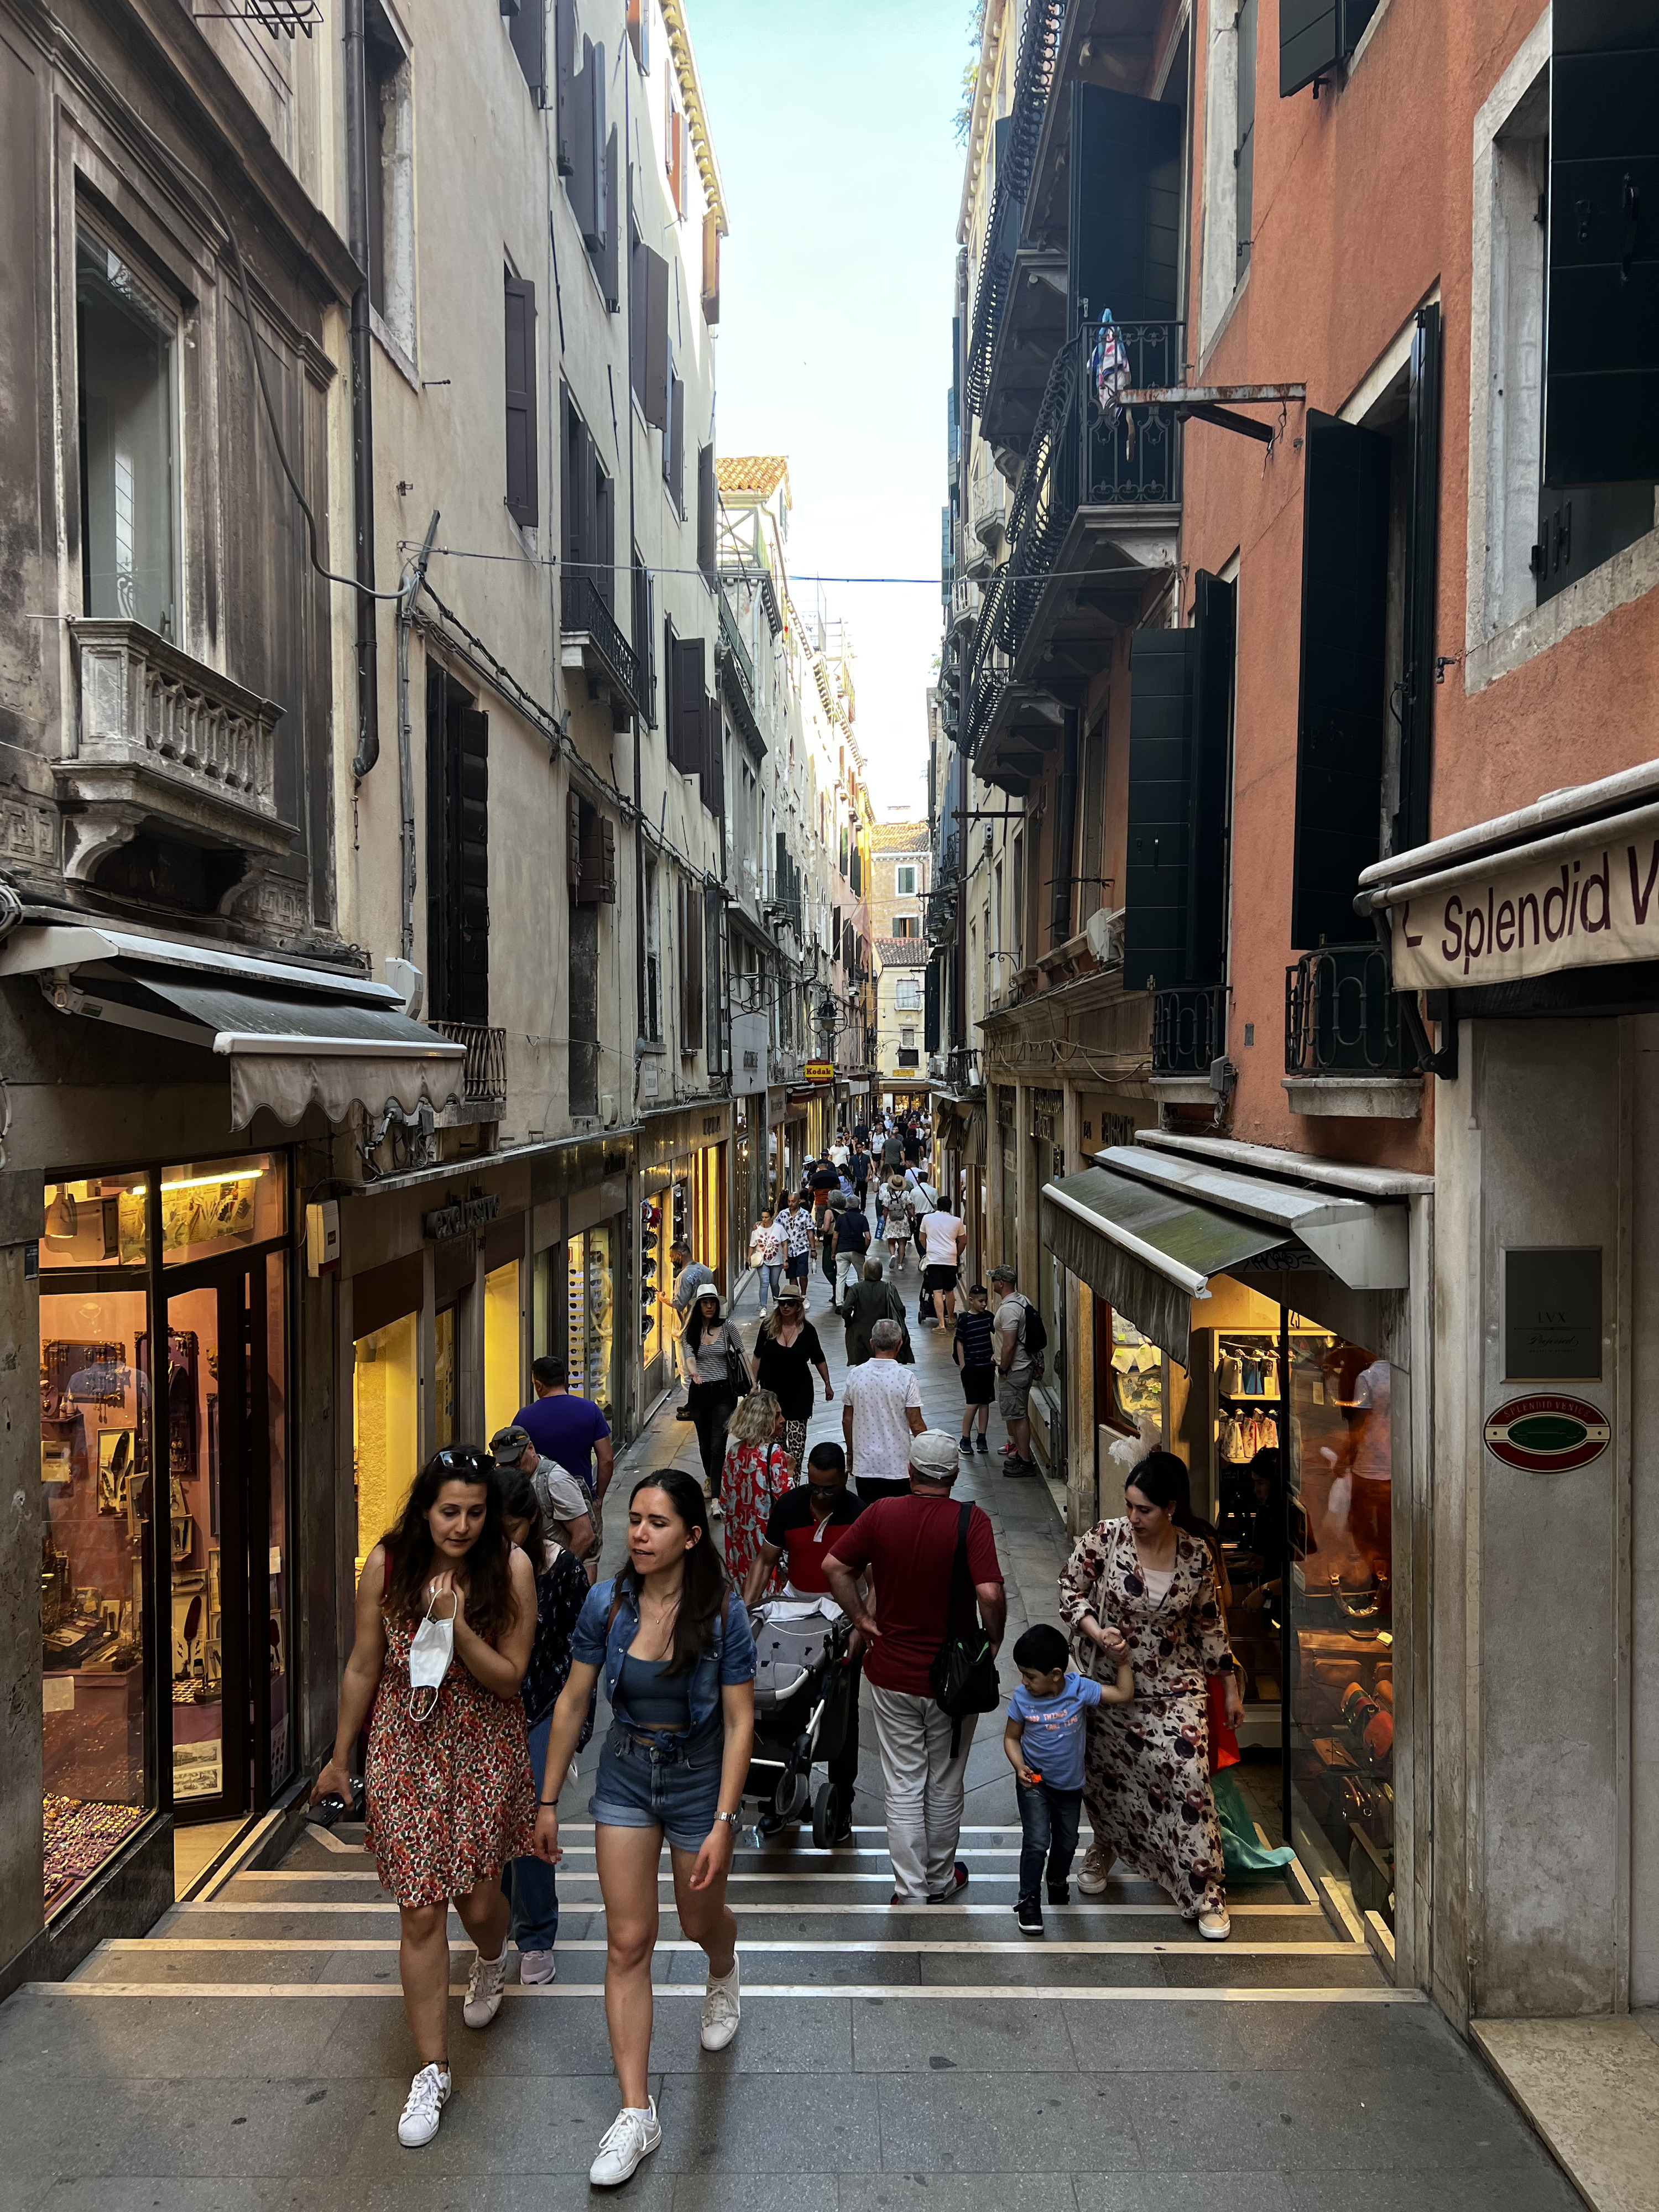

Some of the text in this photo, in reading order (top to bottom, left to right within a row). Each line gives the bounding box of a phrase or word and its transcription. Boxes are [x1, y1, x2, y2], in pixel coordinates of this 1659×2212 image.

[1442, 839, 1659, 975] Splendid V
[431, 1194, 499, 1239] exclusive
[1538, 1311, 1567, 1323] LVX
[1503, 1400, 1591, 1419] SPLENDID VENICE
